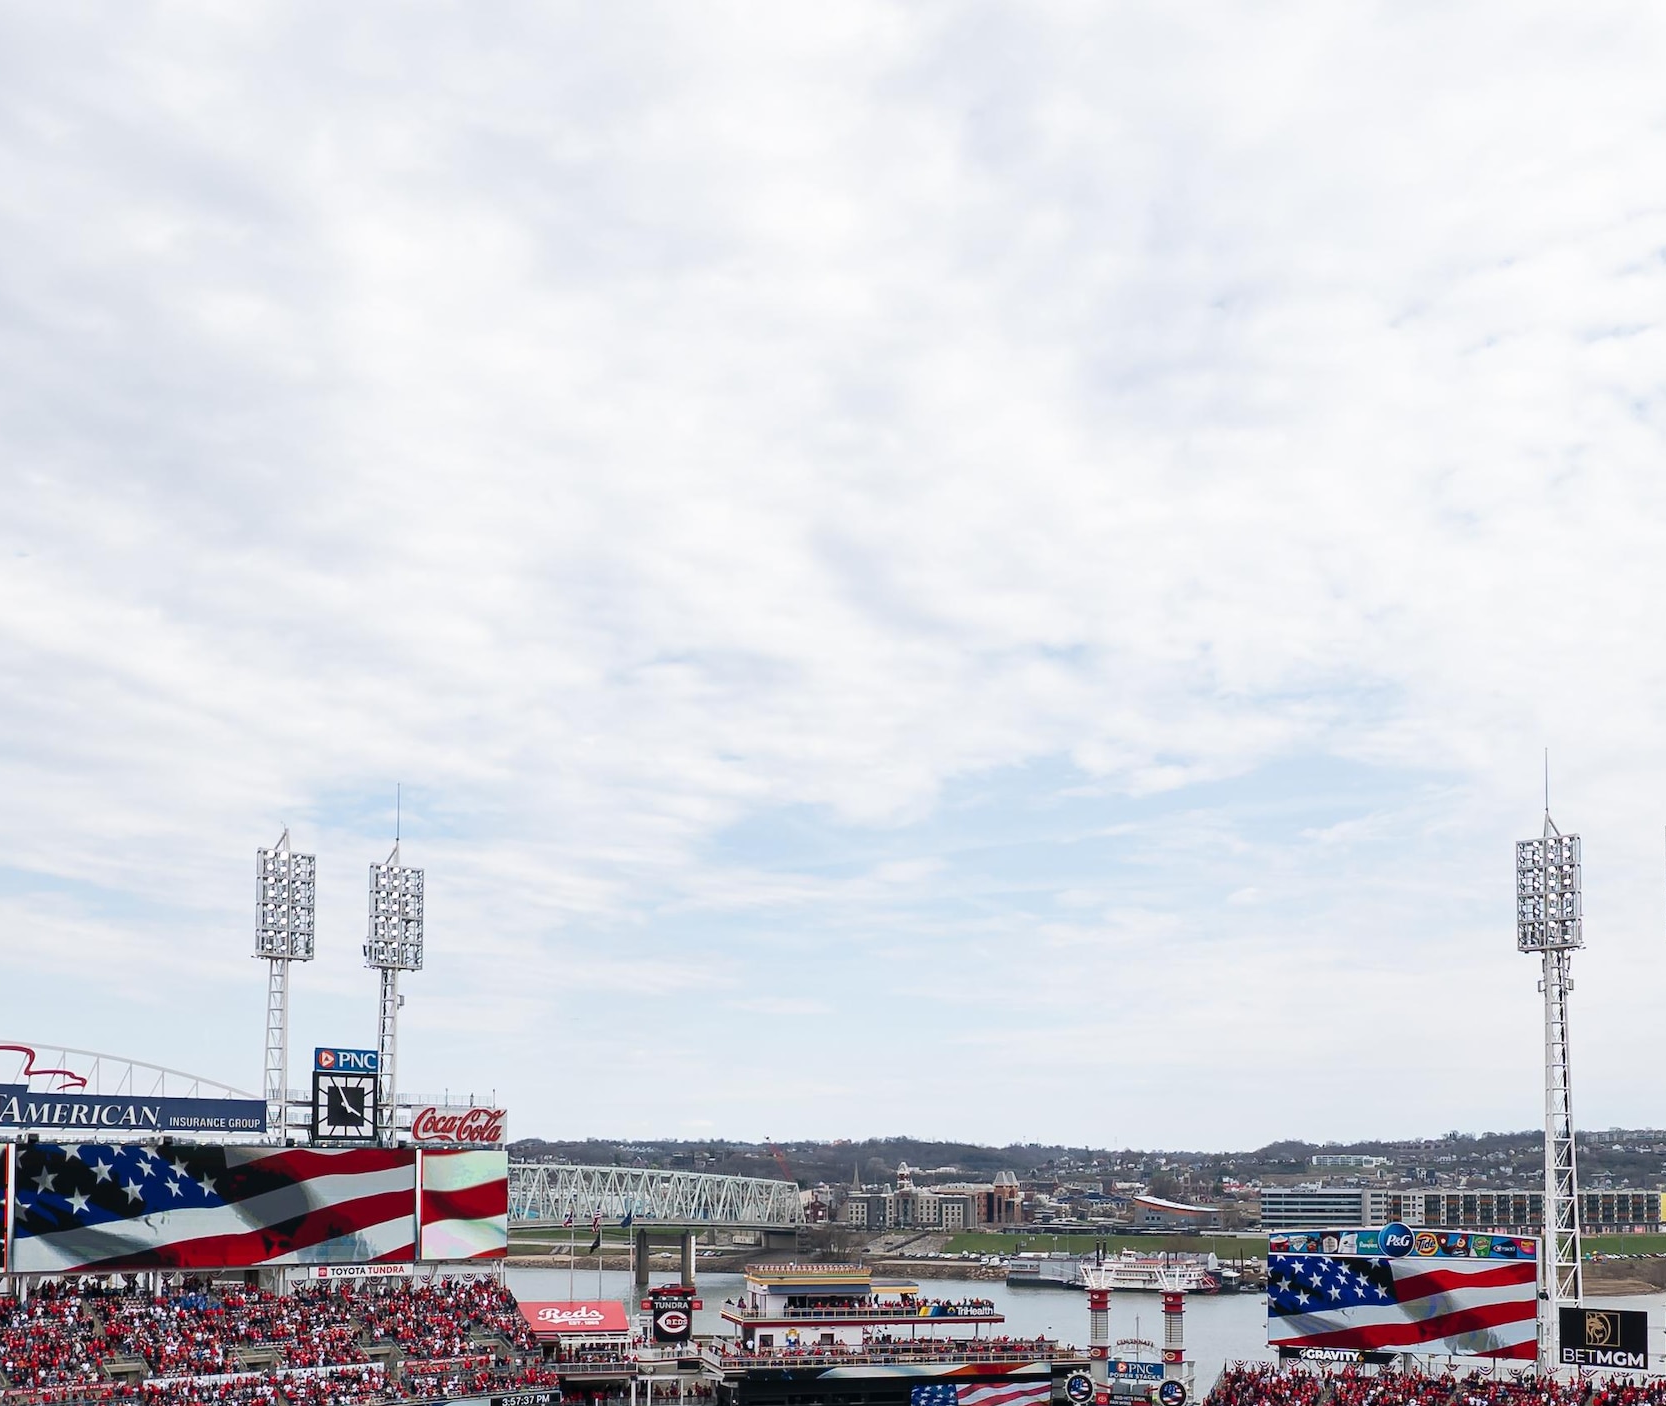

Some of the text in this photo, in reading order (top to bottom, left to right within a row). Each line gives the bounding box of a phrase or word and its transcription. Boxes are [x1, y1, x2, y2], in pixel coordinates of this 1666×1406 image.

[338, 1051, 376, 1070] PNC
[169, 1116, 261, 1129] INSURANCE GROUP
[412, 1106, 507, 1143] Coca-Cola
[1386, 1234, 1410, 1247] P&G
[331, 1265, 405, 1277] TOYOTA TUNDRA
[537, 1306, 605, 1324] Reds
[956, 1304, 994, 1317] TriHealth
[1306, 1348, 1360, 1362] GRAVITY
[1562, 1348, 1645, 1368] BETMGM
[1129, 1364, 1154, 1374] PNC
[502, 1393, 550, 1406] 3:57:37 PM
